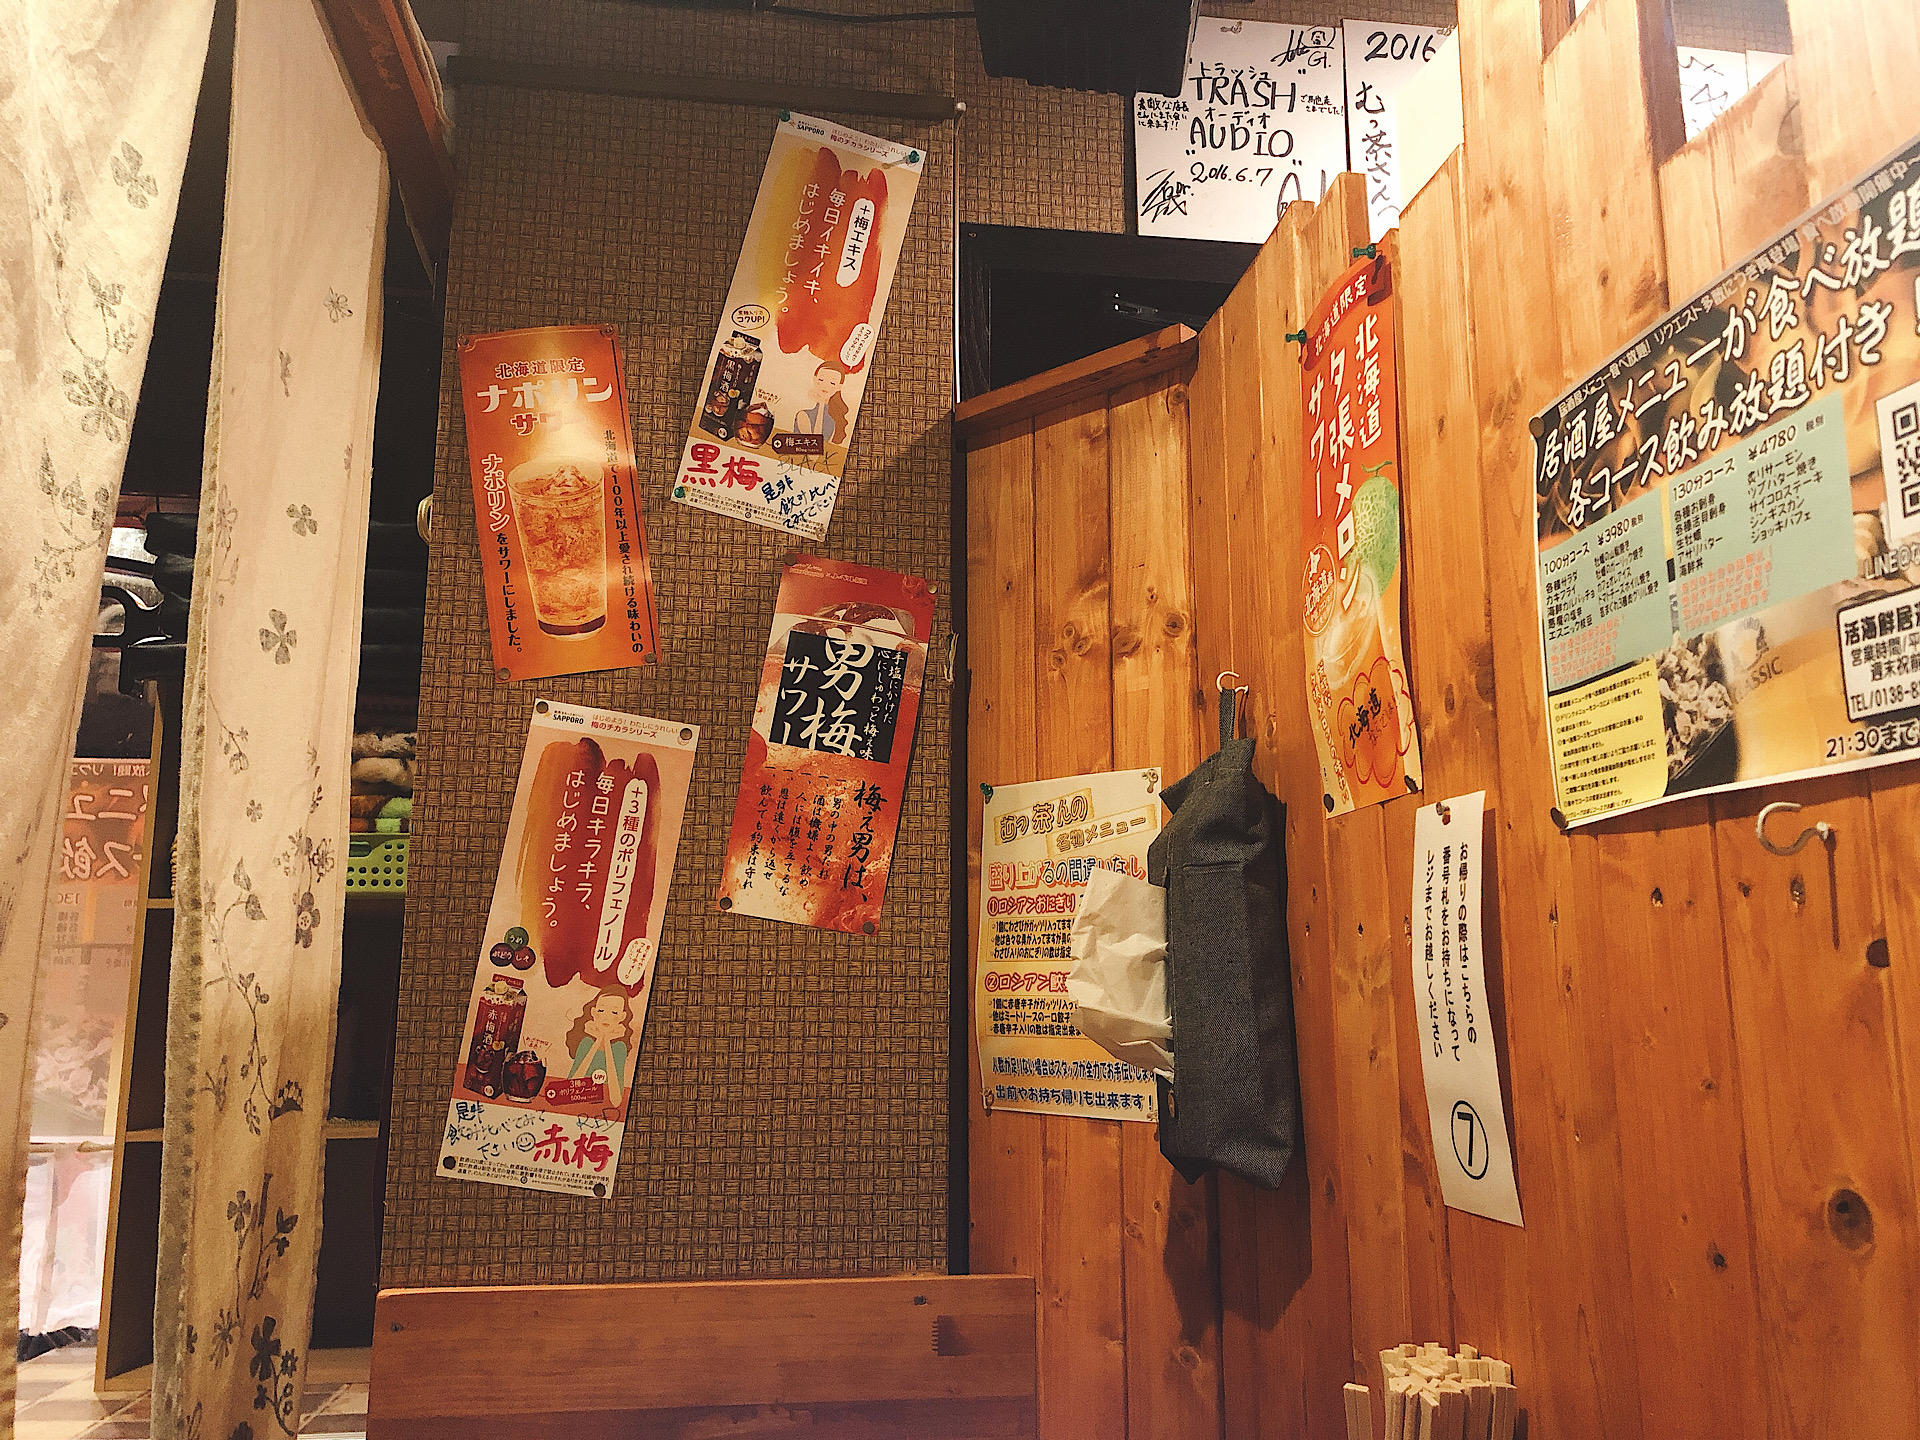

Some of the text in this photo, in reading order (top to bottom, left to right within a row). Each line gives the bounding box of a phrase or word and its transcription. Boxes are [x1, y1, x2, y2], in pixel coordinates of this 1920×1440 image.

[1199, 62, 1272, 82] トラッシュ
[1188, 74, 1297, 113] TRASH
[796, 124, 825, 136] SAPPORO
[1204, 107, 1271, 127] オーディオ
[1189, 116, 1294, 158] AUDIO
[1189, 161, 1274, 187] 2016.6.7
[775, 183, 821, 313] はじめましょう。
[1315, 274, 1368, 356] 北海道限定
[1539, 174, 1920, 483] 居酒屋メニューが食べ放題
[496, 357, 586, 380] 北海道限定
[1354, 313, 1383, 451] 北海道
[784, 436, 818, 448] 梅エキス
[1307, 371, 1326, 519] サワー
[682, 443, 764, 492] 黒梅
[1327, 347, 1362, 612] 夕張メロン
[1671, 458, 1736, 503] 130分コース
[1748, 425, 1797, 462] ¥4780
[761, 474, 794, 504] 是非
[1673, 492, 1716, 524] 各種お刺身
[1749, 470, 1824, 513] サイコロステーキ
[1750, 496, 1806, 530] ジンギスカン
[1751, 511, 1813, 545] ジョッキパフェ
[1544, 541, 1591, 576] 100分コース
[1597, 518, 1630, 547] ¥3980
[1677, 536, 1724, 564] アサリバター
[1545, 570, 1579, 594] 各種サラダ
[1545, 584, 1577, 606] カキフライ
[1548, 614, 1594, 641] エスニック枝豆
[780, 655, 820, 746] サワー
[799, 638, 876, 760] 男梅
[883, 651, 905, 724] 手塩にかけた
[552, 713, 585, 725] SAPPORO
[590, 720, 658, 739] 梅のチカラシリーズ
[1349, 687, 1382, 750] 北海道
[1826, 720, 1919, 759] 21:30まで
[541, 769, 586, 928] はじめましょう。
[575, 771, 615, 911] 毎日キラキラ、
[1056, 816, 1147, 853] 名物メニュー
[509, 934, 523, 945] うめ
[1424, 849, 1444, 1058] レジまでお越しください
[1441, 845, 1461, 1062] 番号札をお持ちになって
[1457, 842, 1478, 1043] お帰りの際はこちらの
[455, 1100, 485, 1125] 是非
[575, 1107, 621, 1133] RED
[532, 1123, 614, 1173] 赤梅
